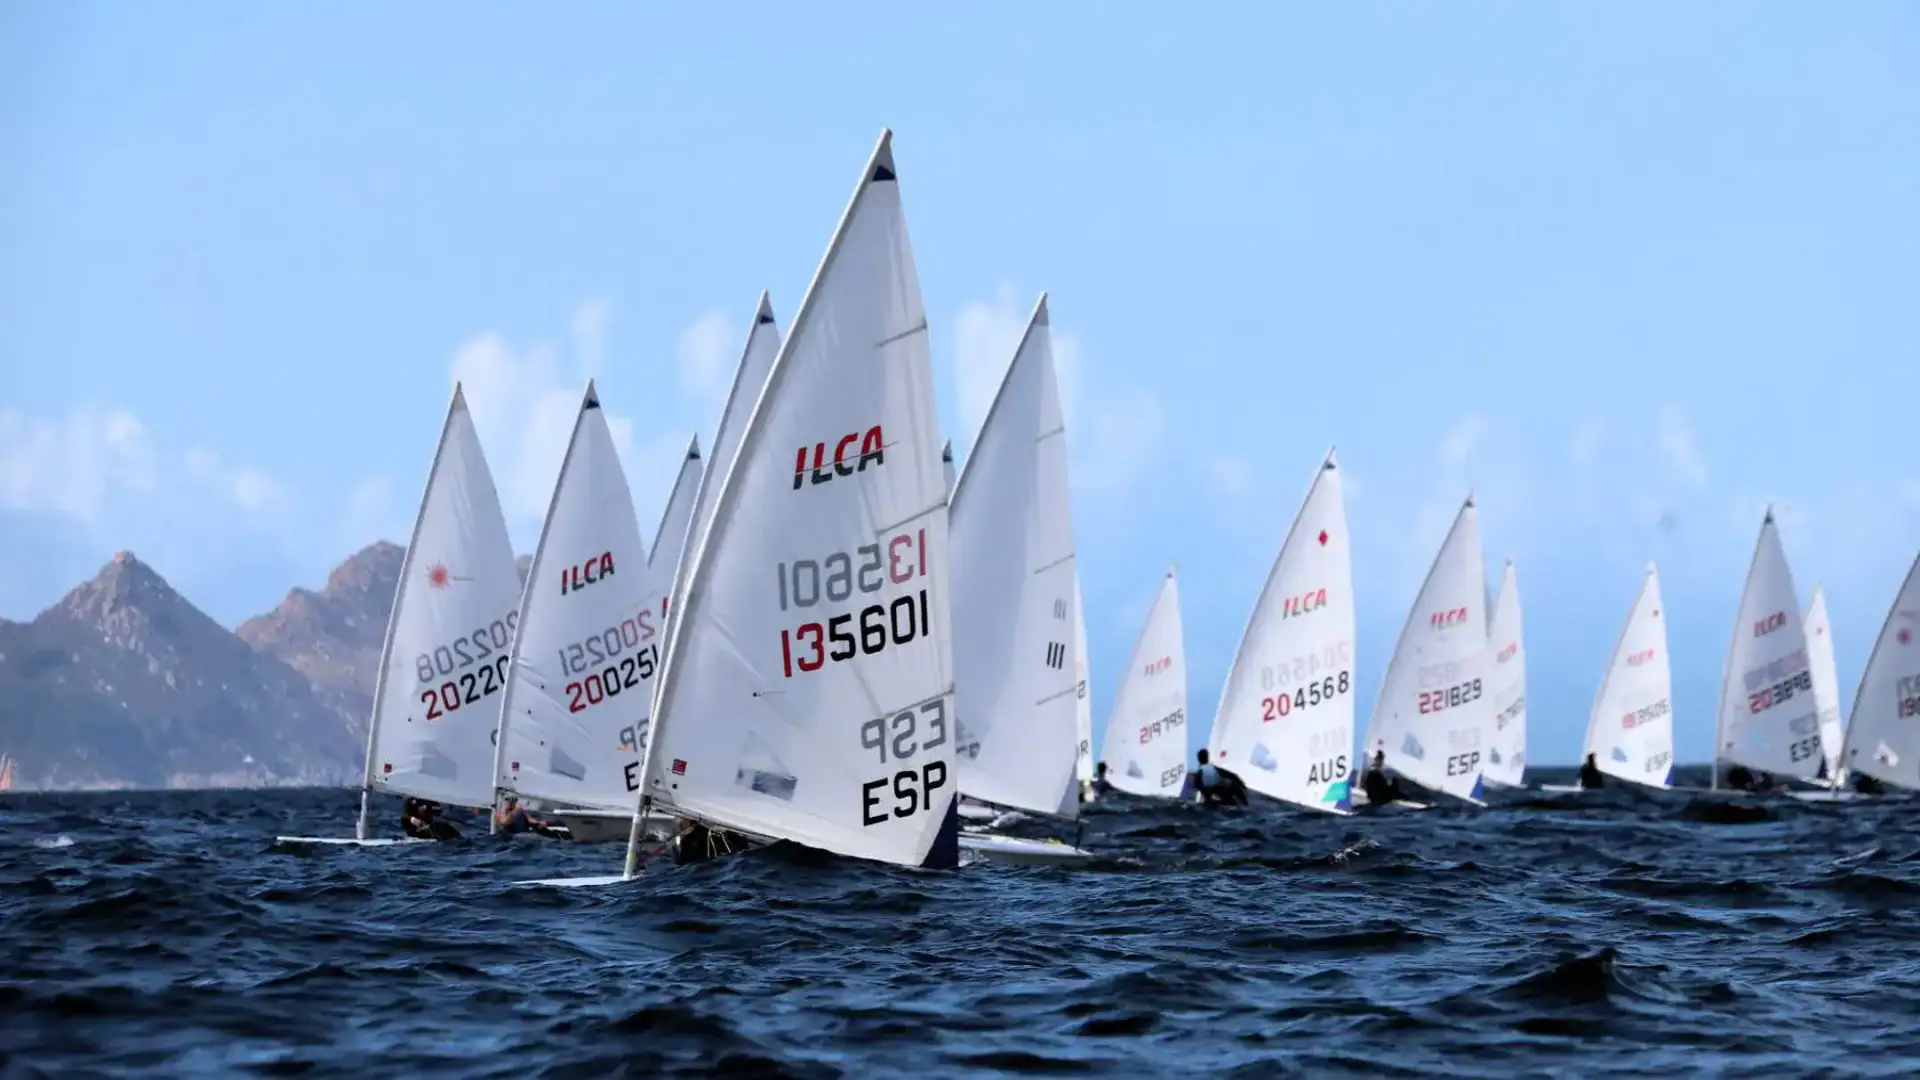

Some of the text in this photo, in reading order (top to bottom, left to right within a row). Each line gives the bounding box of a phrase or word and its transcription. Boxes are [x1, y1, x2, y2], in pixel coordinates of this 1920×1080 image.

[793, 425, 884, 490] ILCA
[561, 551, 614, 596] ILCA
[1282, 588, 1327, 620] ILCA
[781, 589, 928, 677] 135601
[565, 644, 659, 713] 200251
[1261, 671, 1349, 722] 204568
[1418, 678, 1483, 715] 221829
[1307, 755, 1347, 786] AUS
[1447, 751, 1481, 777] ESP
[863, 760, 947, 827] ESP
